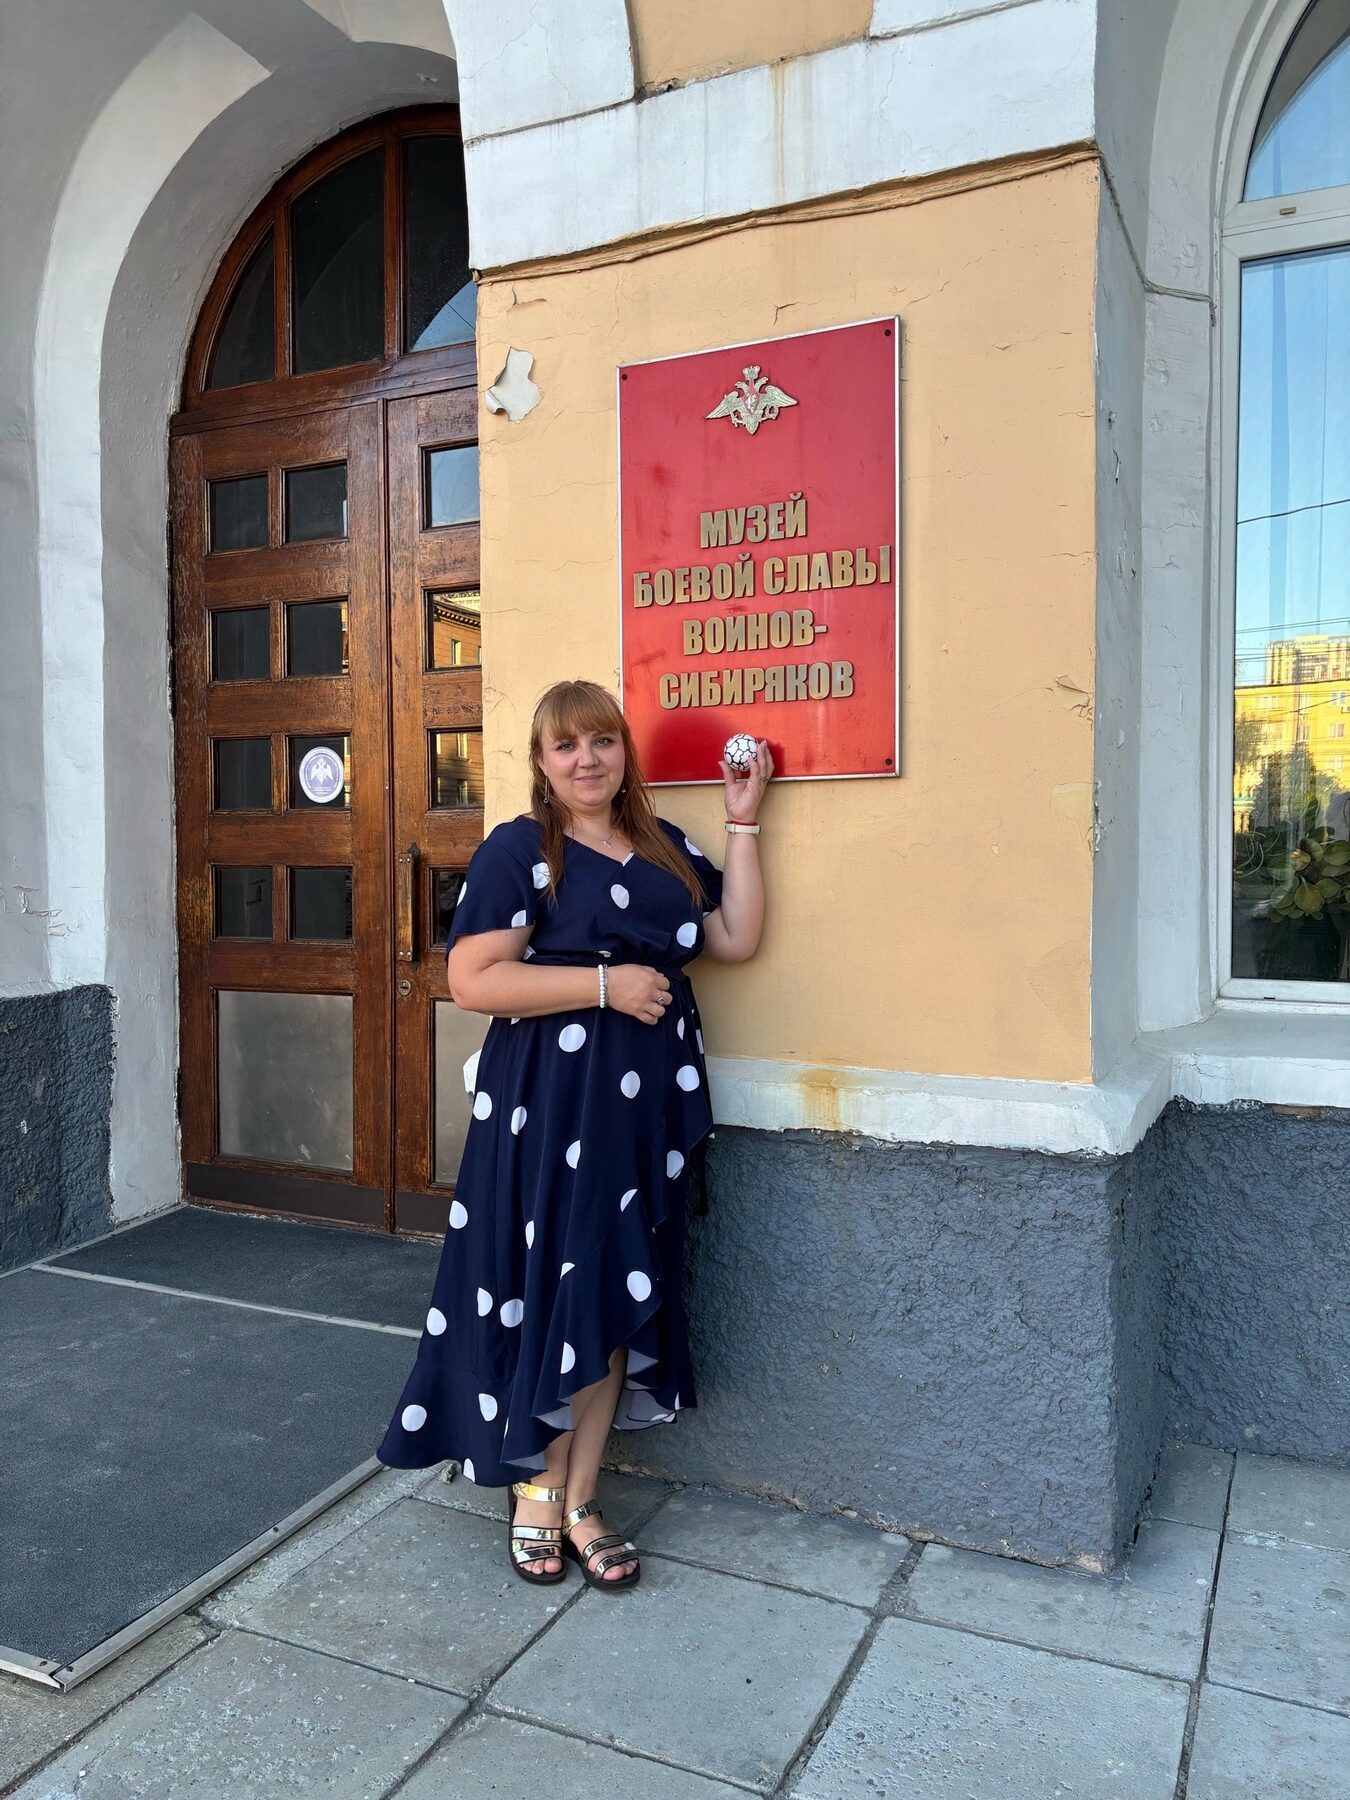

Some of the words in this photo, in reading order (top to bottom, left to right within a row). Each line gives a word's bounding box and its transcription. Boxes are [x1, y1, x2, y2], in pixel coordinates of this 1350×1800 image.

[700, 491, 807, 549] МУЗЕЙ
[633, 552, 755, 608] БОЕВОЙ
[763, 545, 891, 596] СЛАВЫ
[683, 609, 828, 656] ВОИНОВ-
[659, 660, 854, 709] СИБИРЯКОВ
